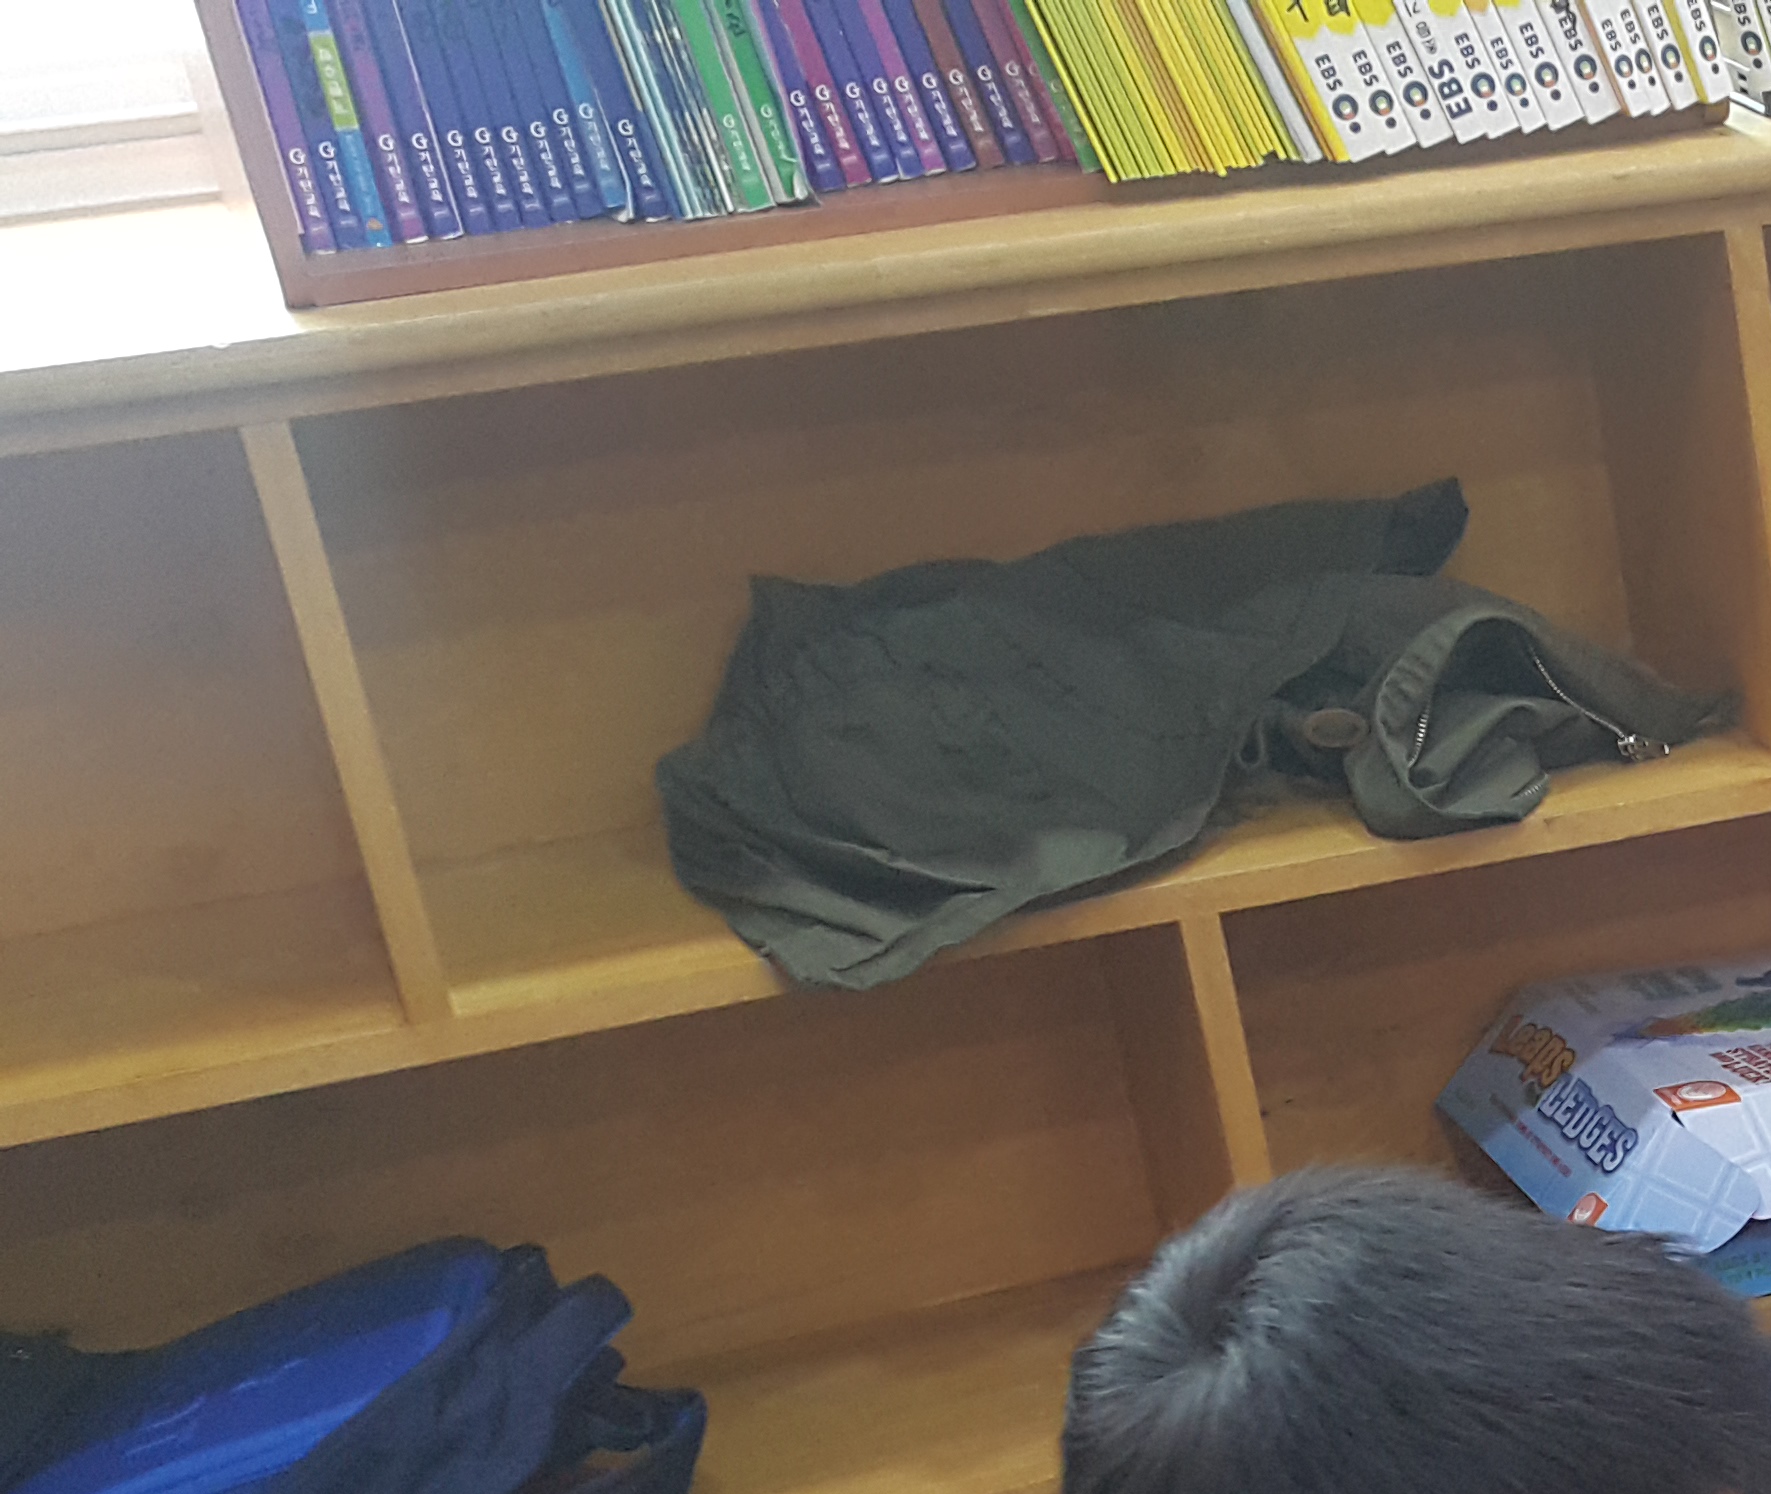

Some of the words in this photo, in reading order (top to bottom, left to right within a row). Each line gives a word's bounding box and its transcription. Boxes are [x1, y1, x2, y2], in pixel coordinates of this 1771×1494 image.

[1519, 22, 1545, 59] EBS
[1600, 18, 1622, 51] EBS
[1620, 8, 1641, 45] EBS
[1648, 5, 1670, 41] EBS
[1352, 49, 1380, 88] EBS
[1386, 40, 1414, 79] EBS
[1454, 32, 1481, 70] EBS
[1490, 36, 1514, 71] EBS
[1314, 53, 1344, 92] EBS
[1428, 58, 1473, 120] EBS
[1537, 1072, 1639, 1174] LEDGES
